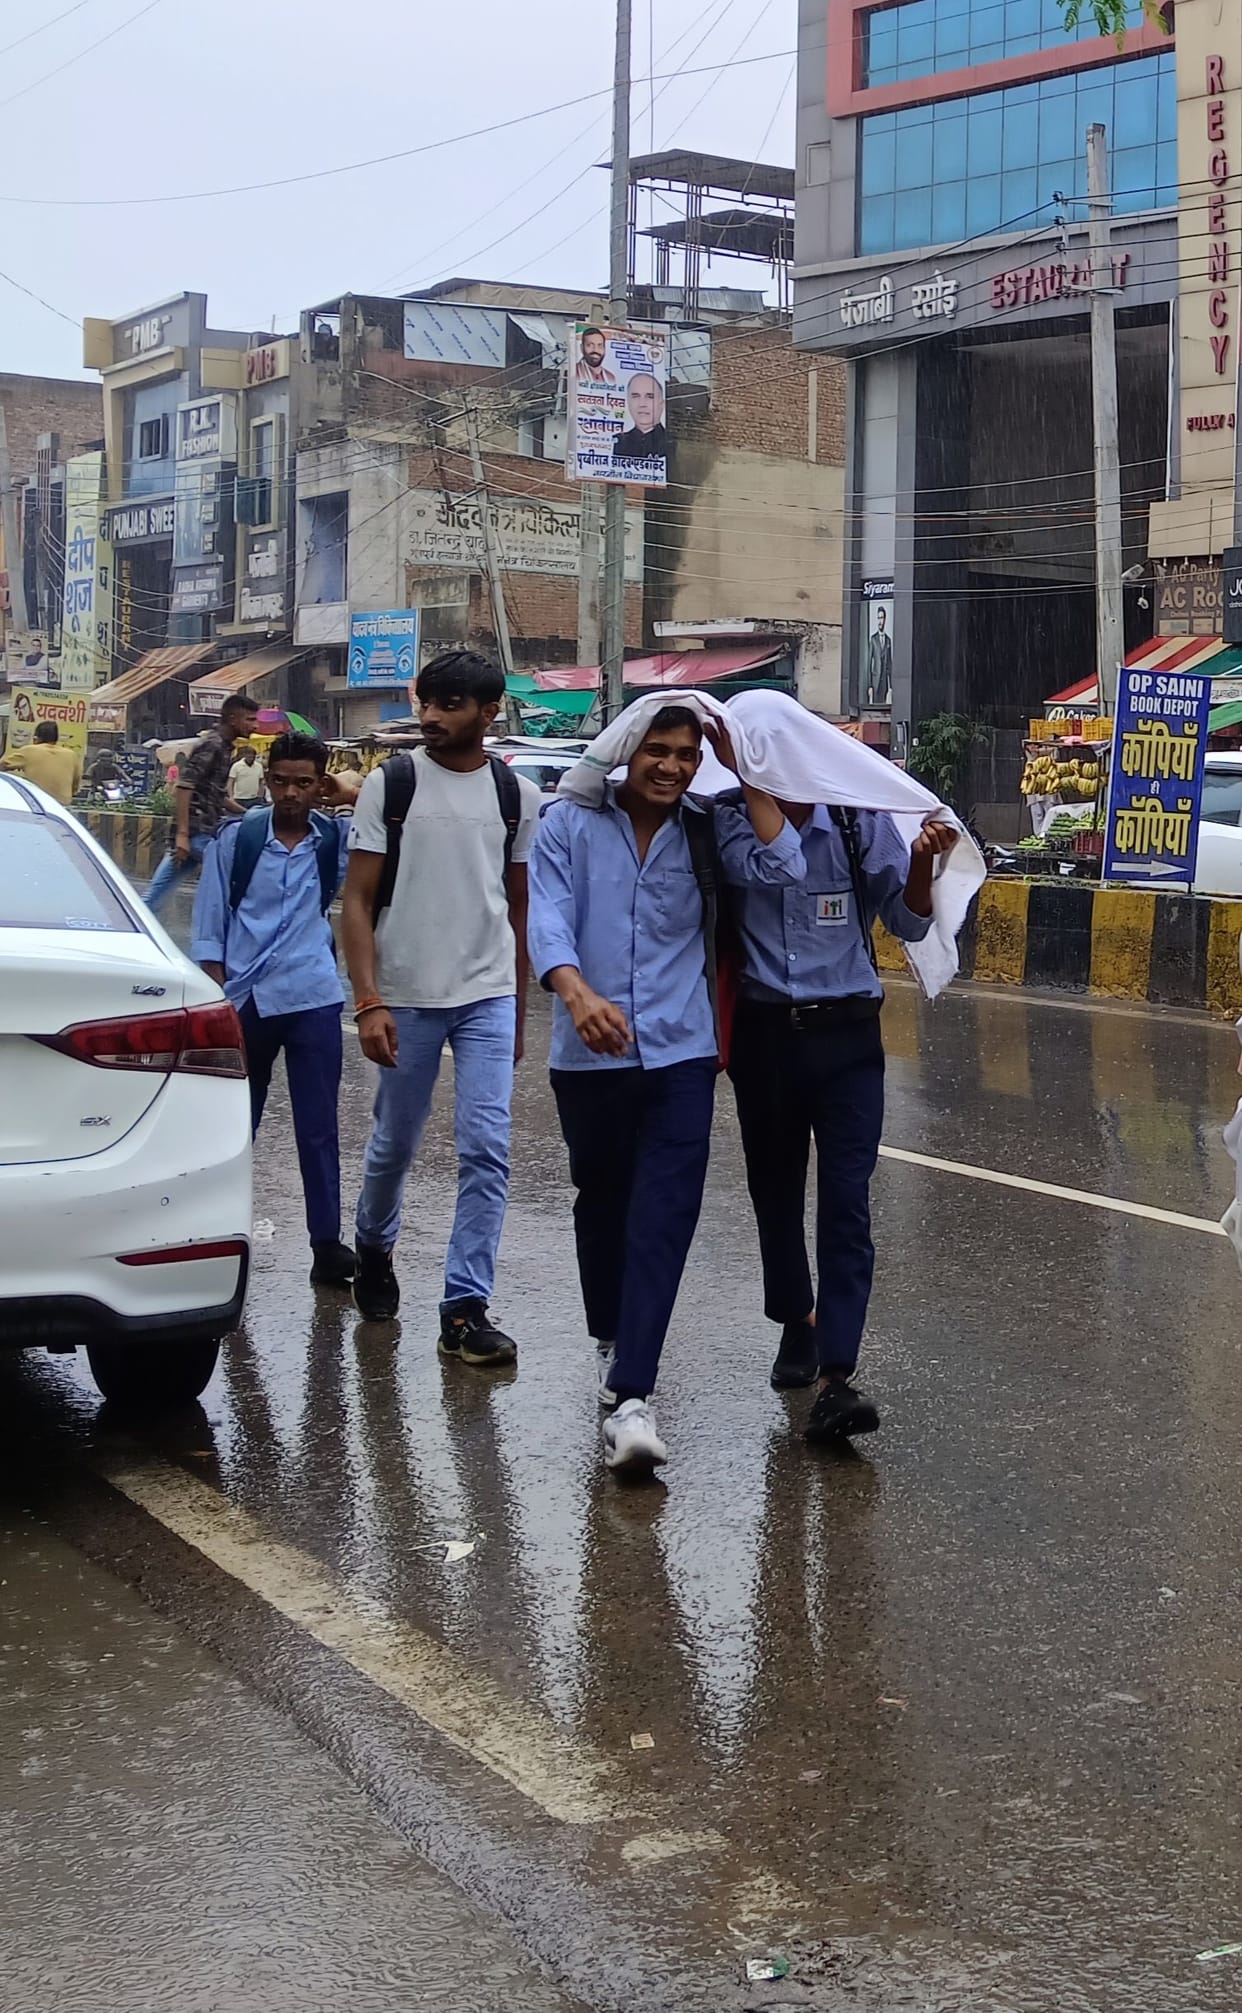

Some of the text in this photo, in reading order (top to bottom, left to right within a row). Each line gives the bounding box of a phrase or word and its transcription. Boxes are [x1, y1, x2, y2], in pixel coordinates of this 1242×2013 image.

[1206, 54, 1230, 376] REGENCY
[113, 508, 148, 541] PUNJABI
[1160, 587, 1187, 609] AC
[1128, 673, 1153, 694] OP
[1156, 675, 1204, 698] SAINI
[1130, 695, 1199, 717] BOOK DEPOT
